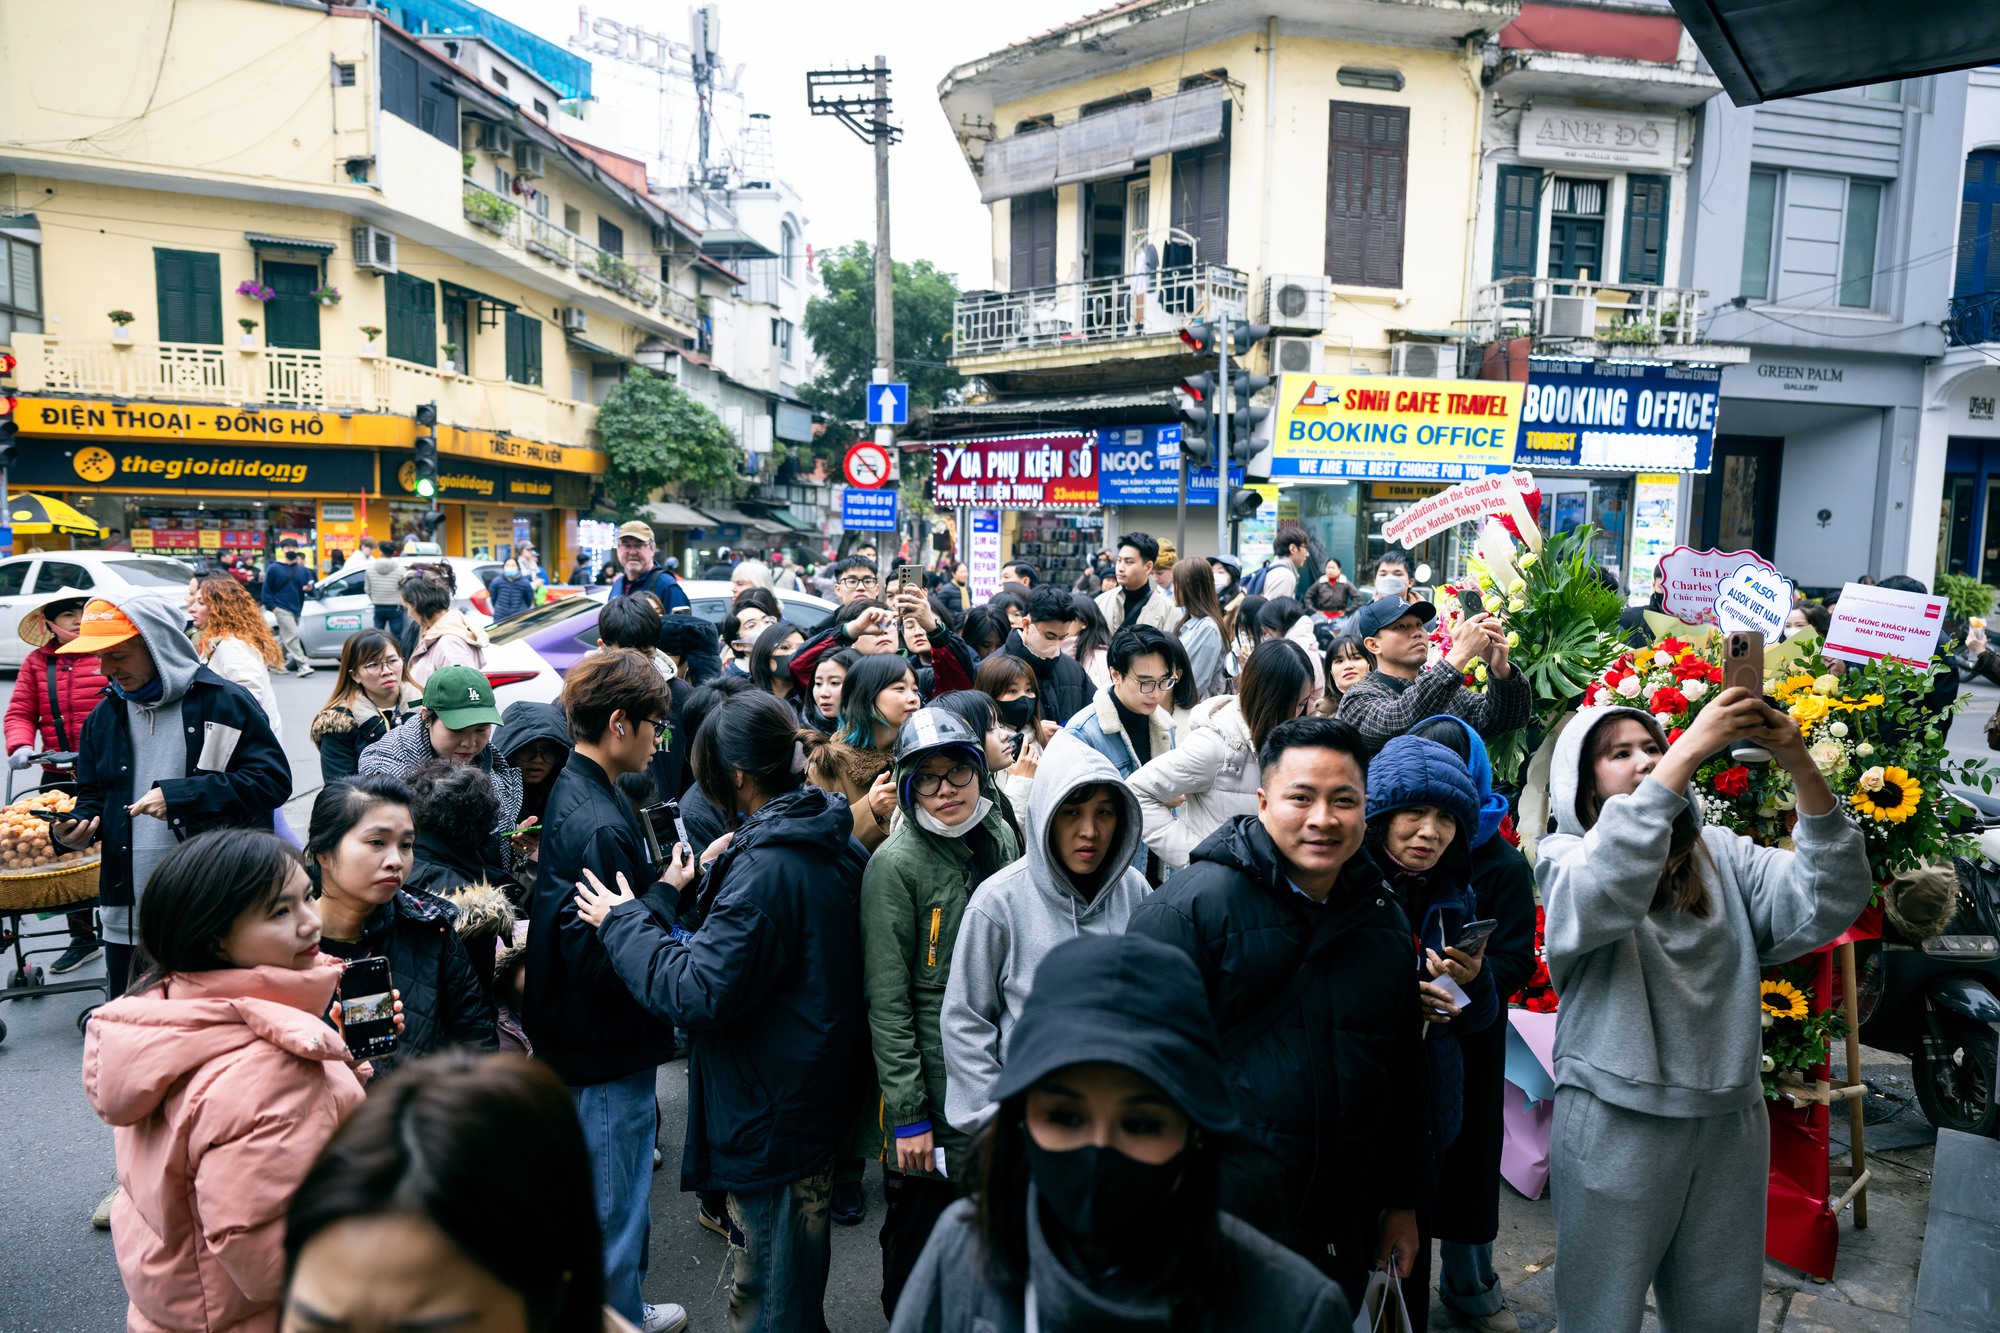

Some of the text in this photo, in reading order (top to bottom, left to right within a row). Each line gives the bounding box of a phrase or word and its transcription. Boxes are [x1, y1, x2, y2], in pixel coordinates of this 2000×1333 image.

[1549, 364, 1566, 374] LOCAL
[1567, 365, 1582, 374] TOUR
[1630, 367, 1644, 377] NAM
[1694, 370, 1719, 382] EXPRESS
[1758, 364, 1843, 382] GREEN PALM
[1783, 383, 1818, 392] GALLERY
[1344, 388, 1509, 417] SINH CAFE TRAVEL
[1523, 384, 1716, 430] BOOKING OFFICE
[40, 405, 324, 436] ĐIỆN THOẠI ĐỒNG HỒ
[1288, 420, 1506, 448] BOOKING OFFICE
[1526, 431, 1577, 451] TOURIST
[489, 440, 520, 456] TABLET
[121, 455, 308, 483] thegioididong
[986, 451, 1020, 484] PHỤ
[1024, 444, 1064, 484] KIỆN
[1101, 451, 1154, 476] NGỌC
[1299, 459, 1486, 479] WE ARE THE BEST CHOICE FOR YOU
[938, 484, 958, 504] PHỤ
[960, 481, 984, 503] KIỆN
[1012, 484, 1044, 504] THOẠI
[1389, 484, 1413, 494] TOÀN
[1386, 502, 1438, 538] Congratulation
[1438, 496, 1449, 507] on
[1450, 490, 1464, 502] the
[1464, 480, 1491, 496] Grand
[1404, 534, 1413, 544] of
[1412, 524, 1427, 540] The
[1426, 512, 1455, 530] Matcha
[1454, 502, 1481, 517] Tokyo
[1691, 567, 1712, 578] Tân
[1672, 580, 1712, 592] Charles
[1751, 582, 1778, 602] ALSOK
[1673, 594, 1693, 602] Chúc
[1727, 588, 1781, 627] ALSOK VIET NAM
[1720, 600, 1771, 639] Congratulations
[1838, 614, 1858, 623] CHÚC
[1881, 622, 1907, 632] KHÁCH
[1908, 627, 1931, 637] HÀNG
[1855, 627, 1905, 642] KHAI TRƯƠNG
